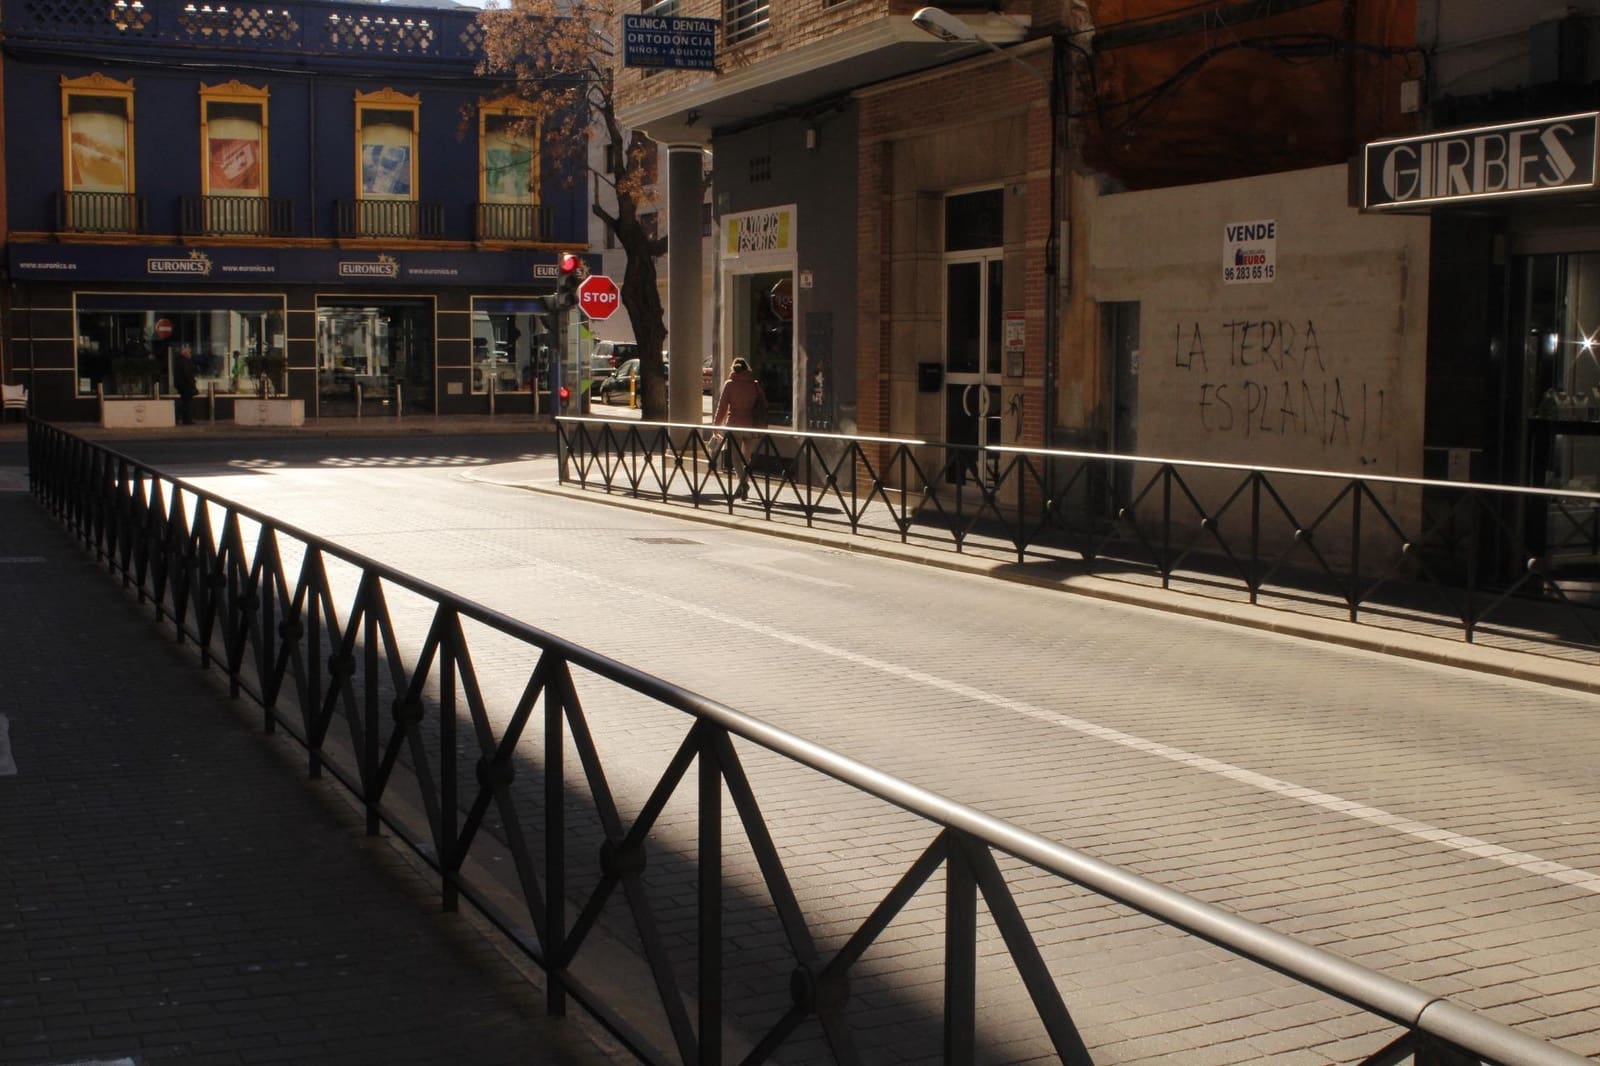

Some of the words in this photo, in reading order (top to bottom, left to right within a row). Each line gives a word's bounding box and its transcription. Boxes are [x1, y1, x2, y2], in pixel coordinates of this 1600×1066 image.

[627, 17, 667, 29] CLINICA
[673, 20, 712, 32] DENTAL
[628, 33, 711, 46] ORTODONCIA
[670, 48, 712, 56] ADULTOS
[1383, 123, 1576, 200] GIRBES
[1227, 222, 1275, 242] VENDE
[738, 231, 778, 253] ESPORTS
[151, 260, 204, 271] EURONICS
[1244, 254, 1266, 265] EURO
[343, 264, 392, 274] EURONICS
[1225, 267, 1234, 280] 96
[1236, 267, 1250, 280] 283
[1265, 264, 1274, 278] 15
[584, 292, 616, 303] STOP
[1175, 322, 1208, 372] LA
[1222, 319, 1325, 373] TERRA
[1200, 384, 1233, 432] ES
